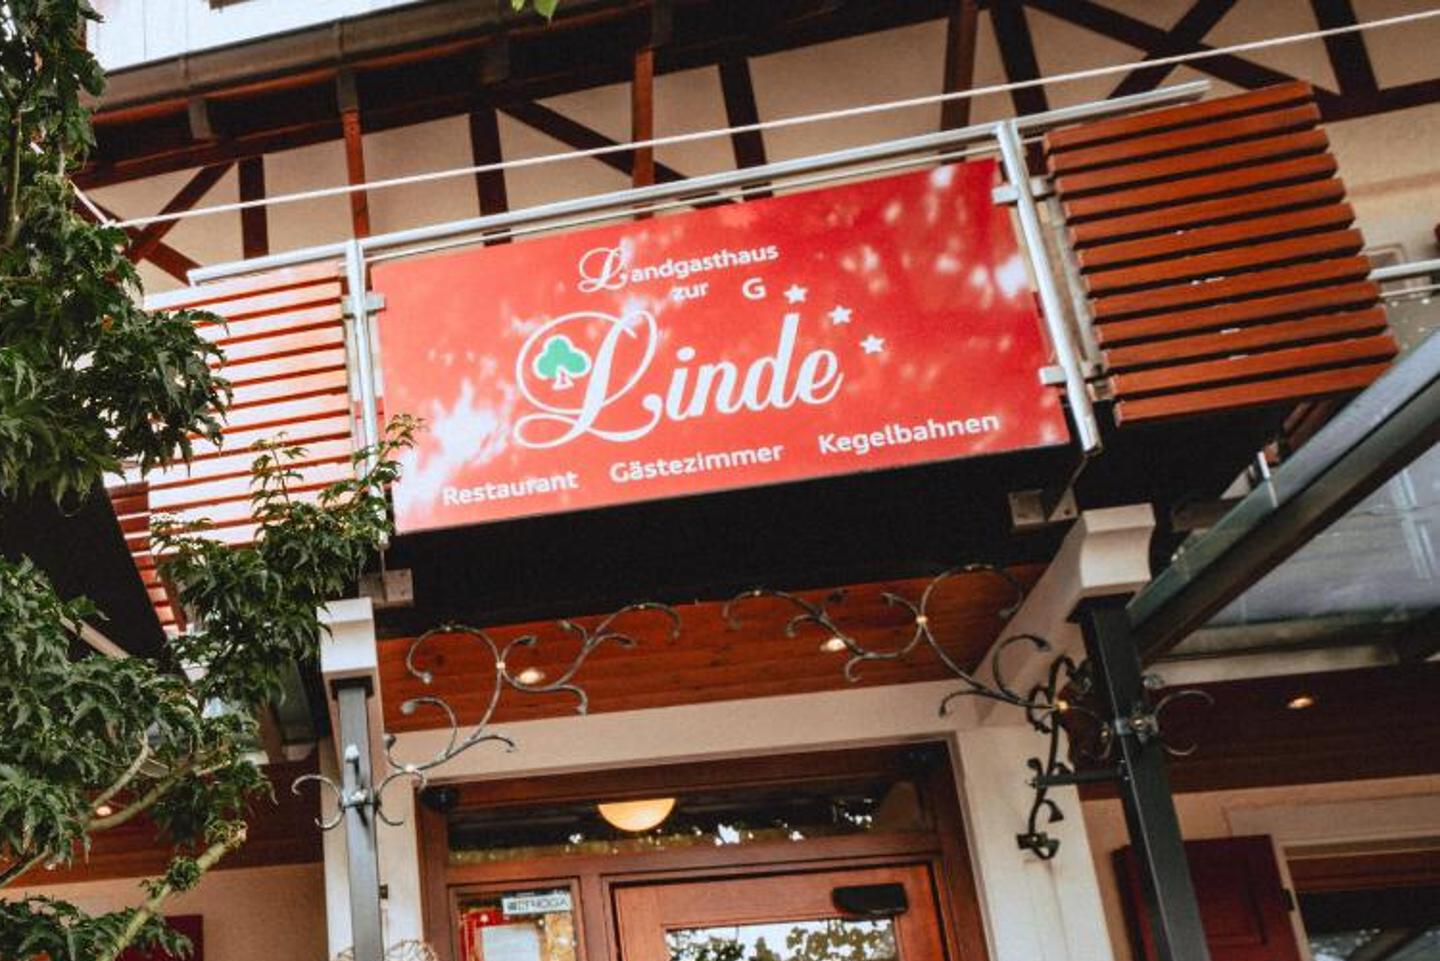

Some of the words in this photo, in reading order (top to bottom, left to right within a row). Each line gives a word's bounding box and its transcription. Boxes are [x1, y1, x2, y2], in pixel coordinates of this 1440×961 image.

[578, 245, 779, 292] Landgasthaus
[671, 281, 710, 301] zur
[741, 277, 767, 299] G
[514, 311, 845, 449] Linde
[442, 470, 579, 506] Restaurant
[609, 443, 784, 484] Gästezimmer
[817, 413, 1000, 455] Kegelbahnen
